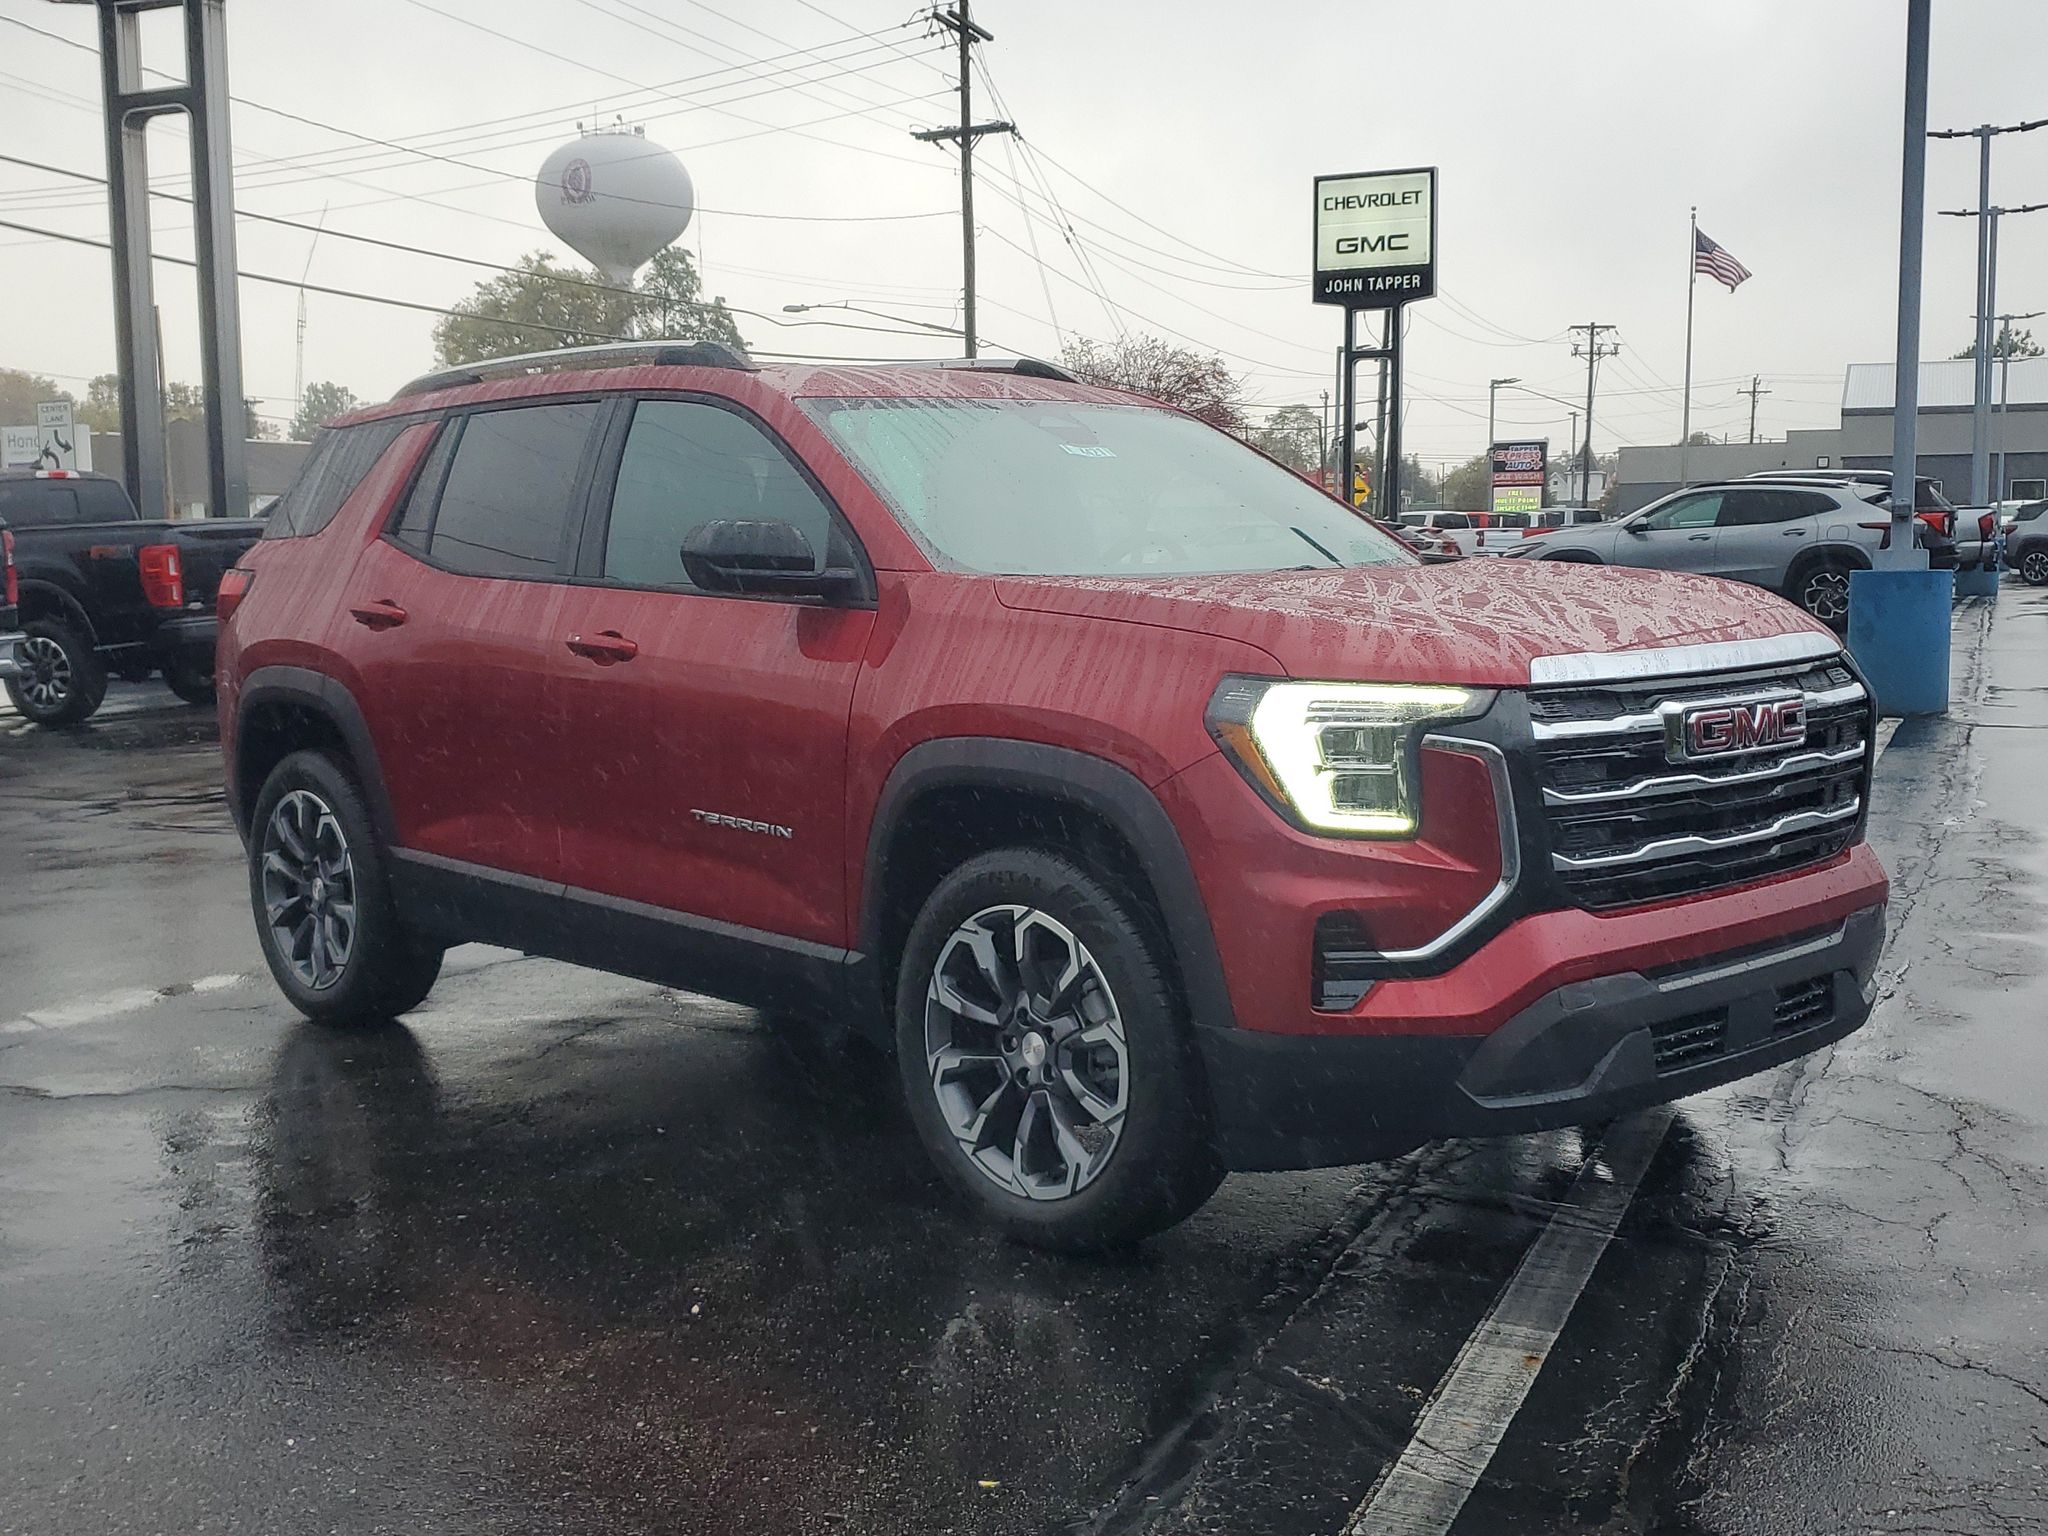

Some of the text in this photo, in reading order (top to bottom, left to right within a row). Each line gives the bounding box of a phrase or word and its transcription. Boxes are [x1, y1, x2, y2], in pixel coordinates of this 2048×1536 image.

[1324, 190, 1423, 211] CHEVROLET
[1336, 233, 1409, 254] GMC
[1325, 274, 1421, 294] JOHN TAPPER
[45, 414, 65, 423] LANE
[1687, 700, 1806, 752] GMC
[689, 808, 793, 839] TERRAIN
